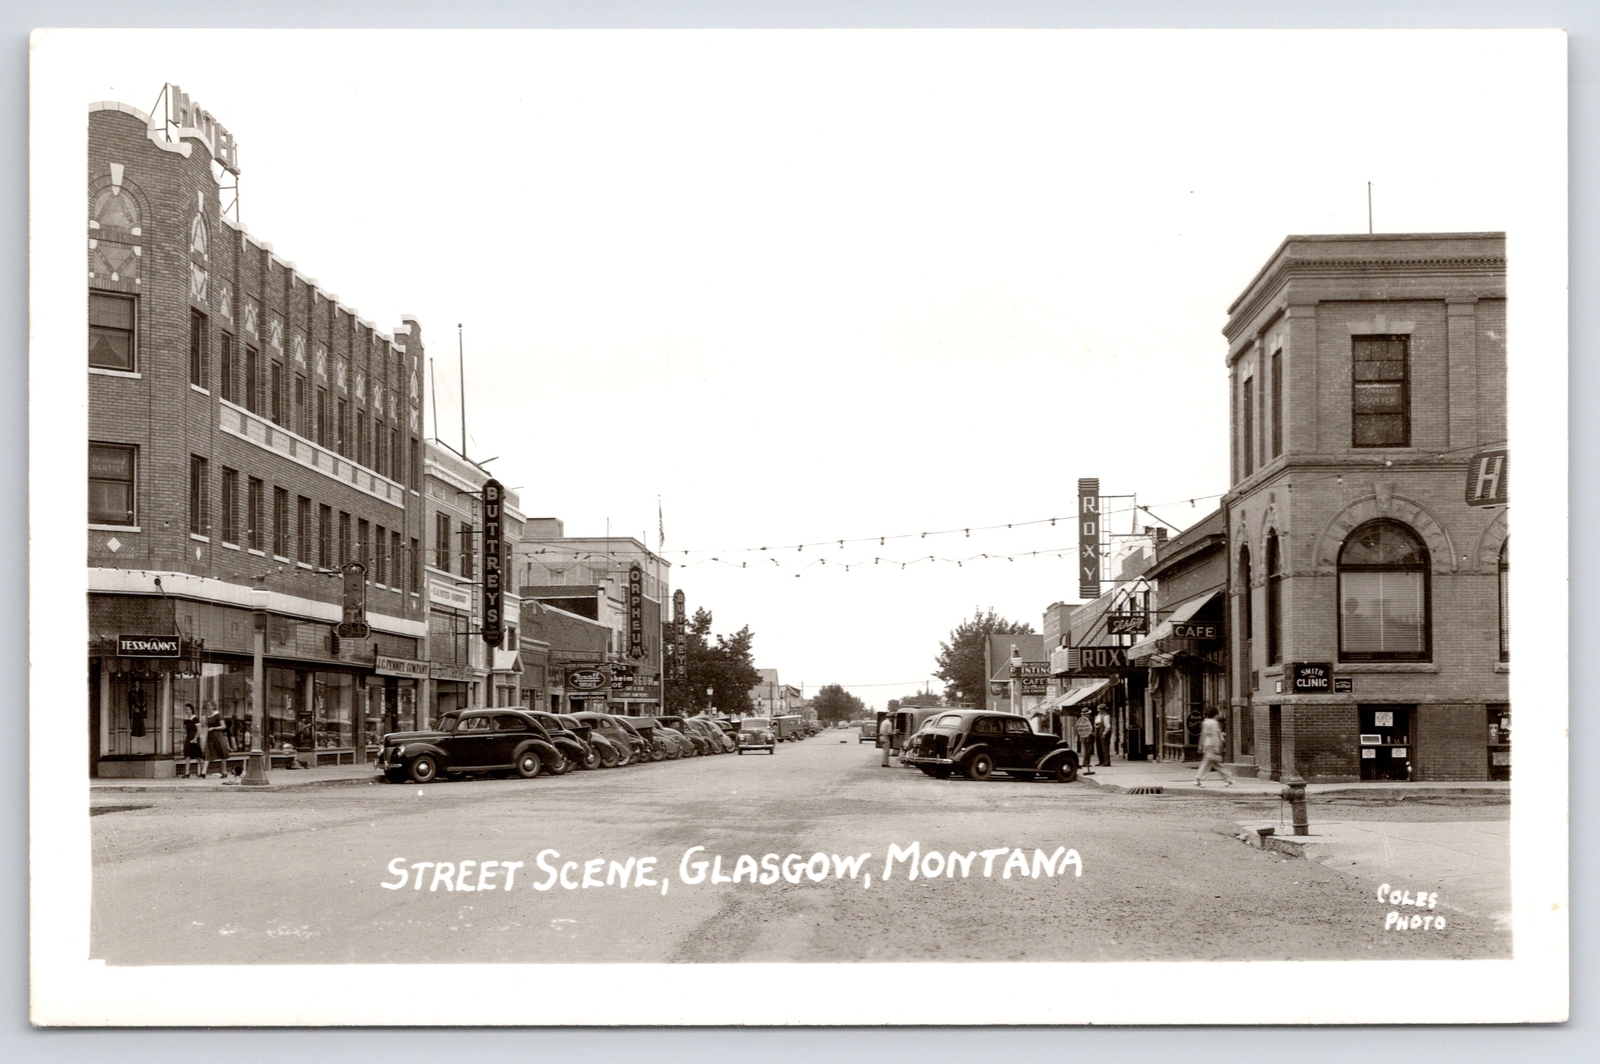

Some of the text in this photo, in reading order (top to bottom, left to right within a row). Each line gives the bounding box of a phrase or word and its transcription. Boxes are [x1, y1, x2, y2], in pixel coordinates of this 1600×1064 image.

[1083, 496, 1097, 581] ROXY
[486, 486, 499, 624] BUTTREYS
[630, 570, 643, 656] ORPHEUM
[677, 593, 686, 675] BUTTREYS
[1174, 626, 1215, 638] CAFE
[120, 640, 178, 652] TESSMANN'S
[1082, 649, 1131, 667] ROXY
[406, 662, 429, 675] COMPANY
[1009, 666, 1051, 674] PINTIN
[1300, 667, 1324, 677] SMITH
[574, 673, 600, 683] Rexall
[1296, 678, 1328, 688] CLINIC
